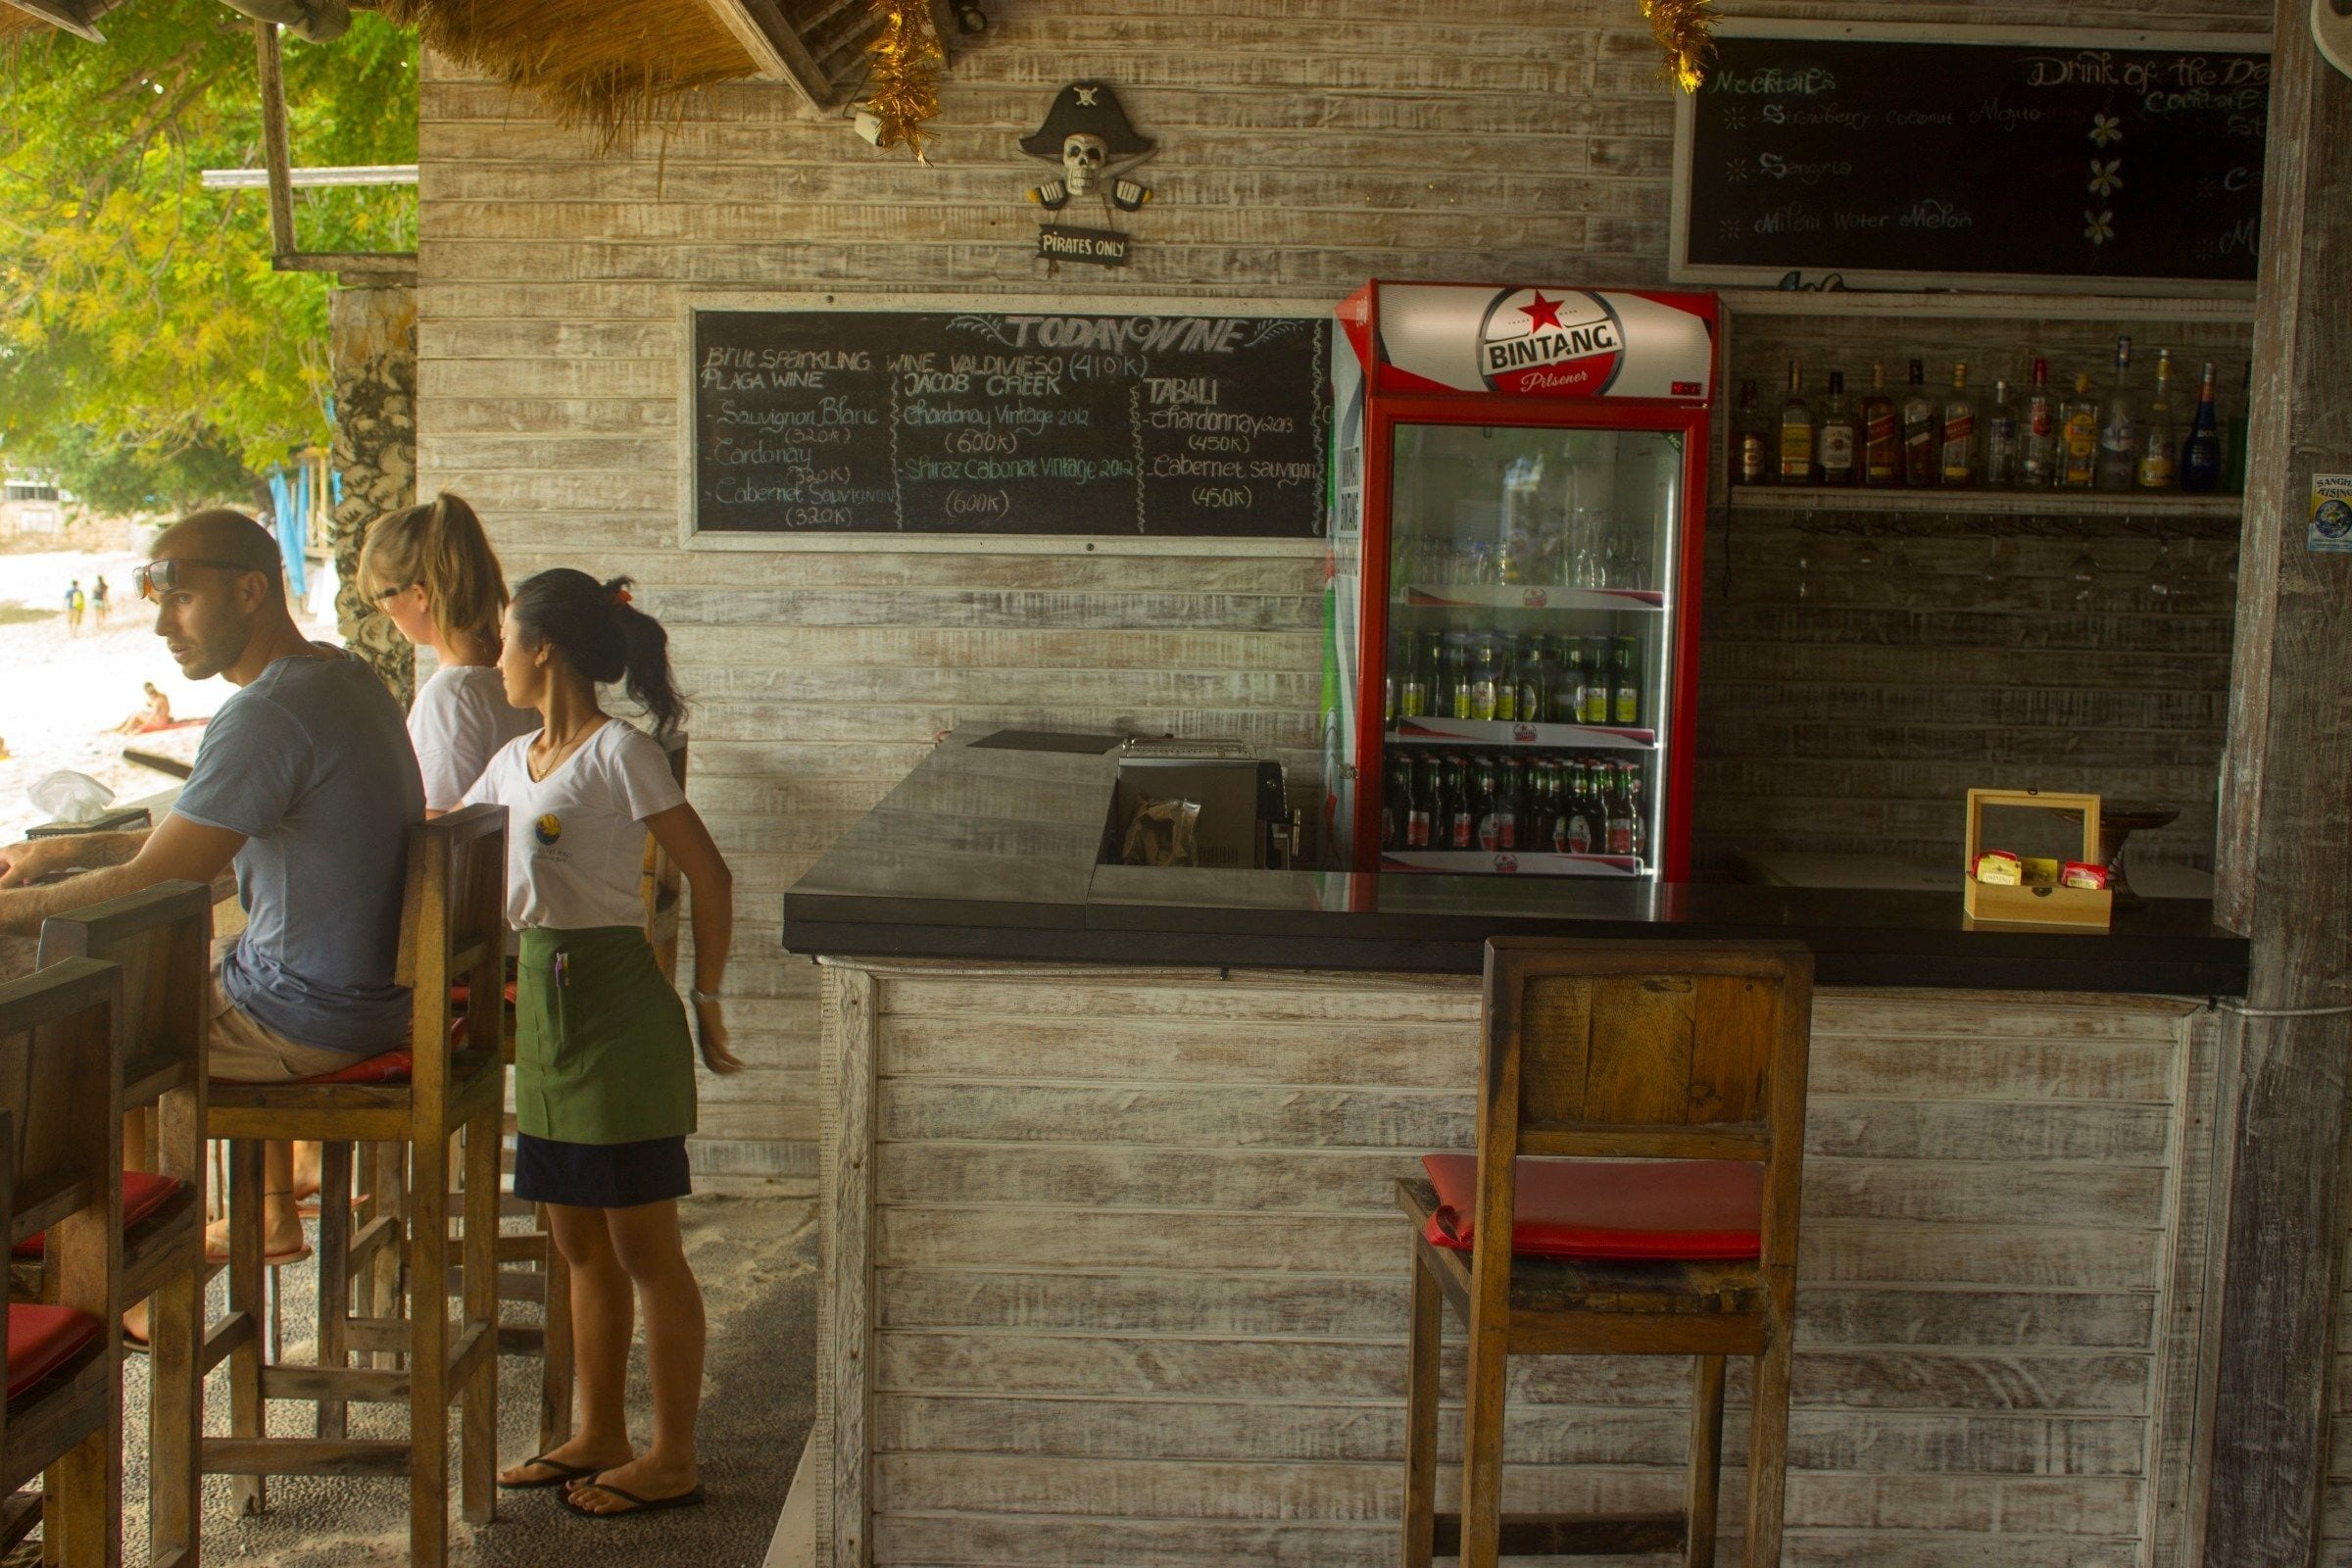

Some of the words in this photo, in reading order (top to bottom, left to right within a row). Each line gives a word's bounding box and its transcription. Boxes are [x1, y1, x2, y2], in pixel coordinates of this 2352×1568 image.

[2014, 51, 2119, 86] Drink
[2123, 61, 2158, 94] of
[2168, 57, 2217, 86] the
[2219, 58, 2270, 86] Da
[1758, 151, 1852, 184] Sangria
[1899, 199, 1973, 229] Melon
[1096, 240, 1124, 258] ONLY
[1005, 316, 1128, 353] TODAY
[1127, 317, 1249, 353] WINE
[1489, 324, 1613, 370] BINTANG
[886, 353, 936, 372] WINE
[951, 355, 1063, 376] VALDIVIESO
[701, 368, 764, 391] PLAGA
[772, 371, 825, 389] WINE
[904, 372, 970, 397] JACOB
[986, 374, 1060, 397] CREEK
[1143, 377, 1218, 406] TABALI
[1520, 368, 1589, 392] Pilsener
[717, 398, 815, 433] Sauvignon
[816, 395, 878, 427] Blanc
[995, 399, 1054, 436] Vintage
[1057, 410, 1089, 426] 2012
[1188, 434, 1250, 454] (450K)
[905, 454, 959, 480] Shiraz
[1098, 459, 1135, 477] 2012
[1153, 453, 1246, 478] Cabernet
[1192, 485, 1253, 509] (450K)
